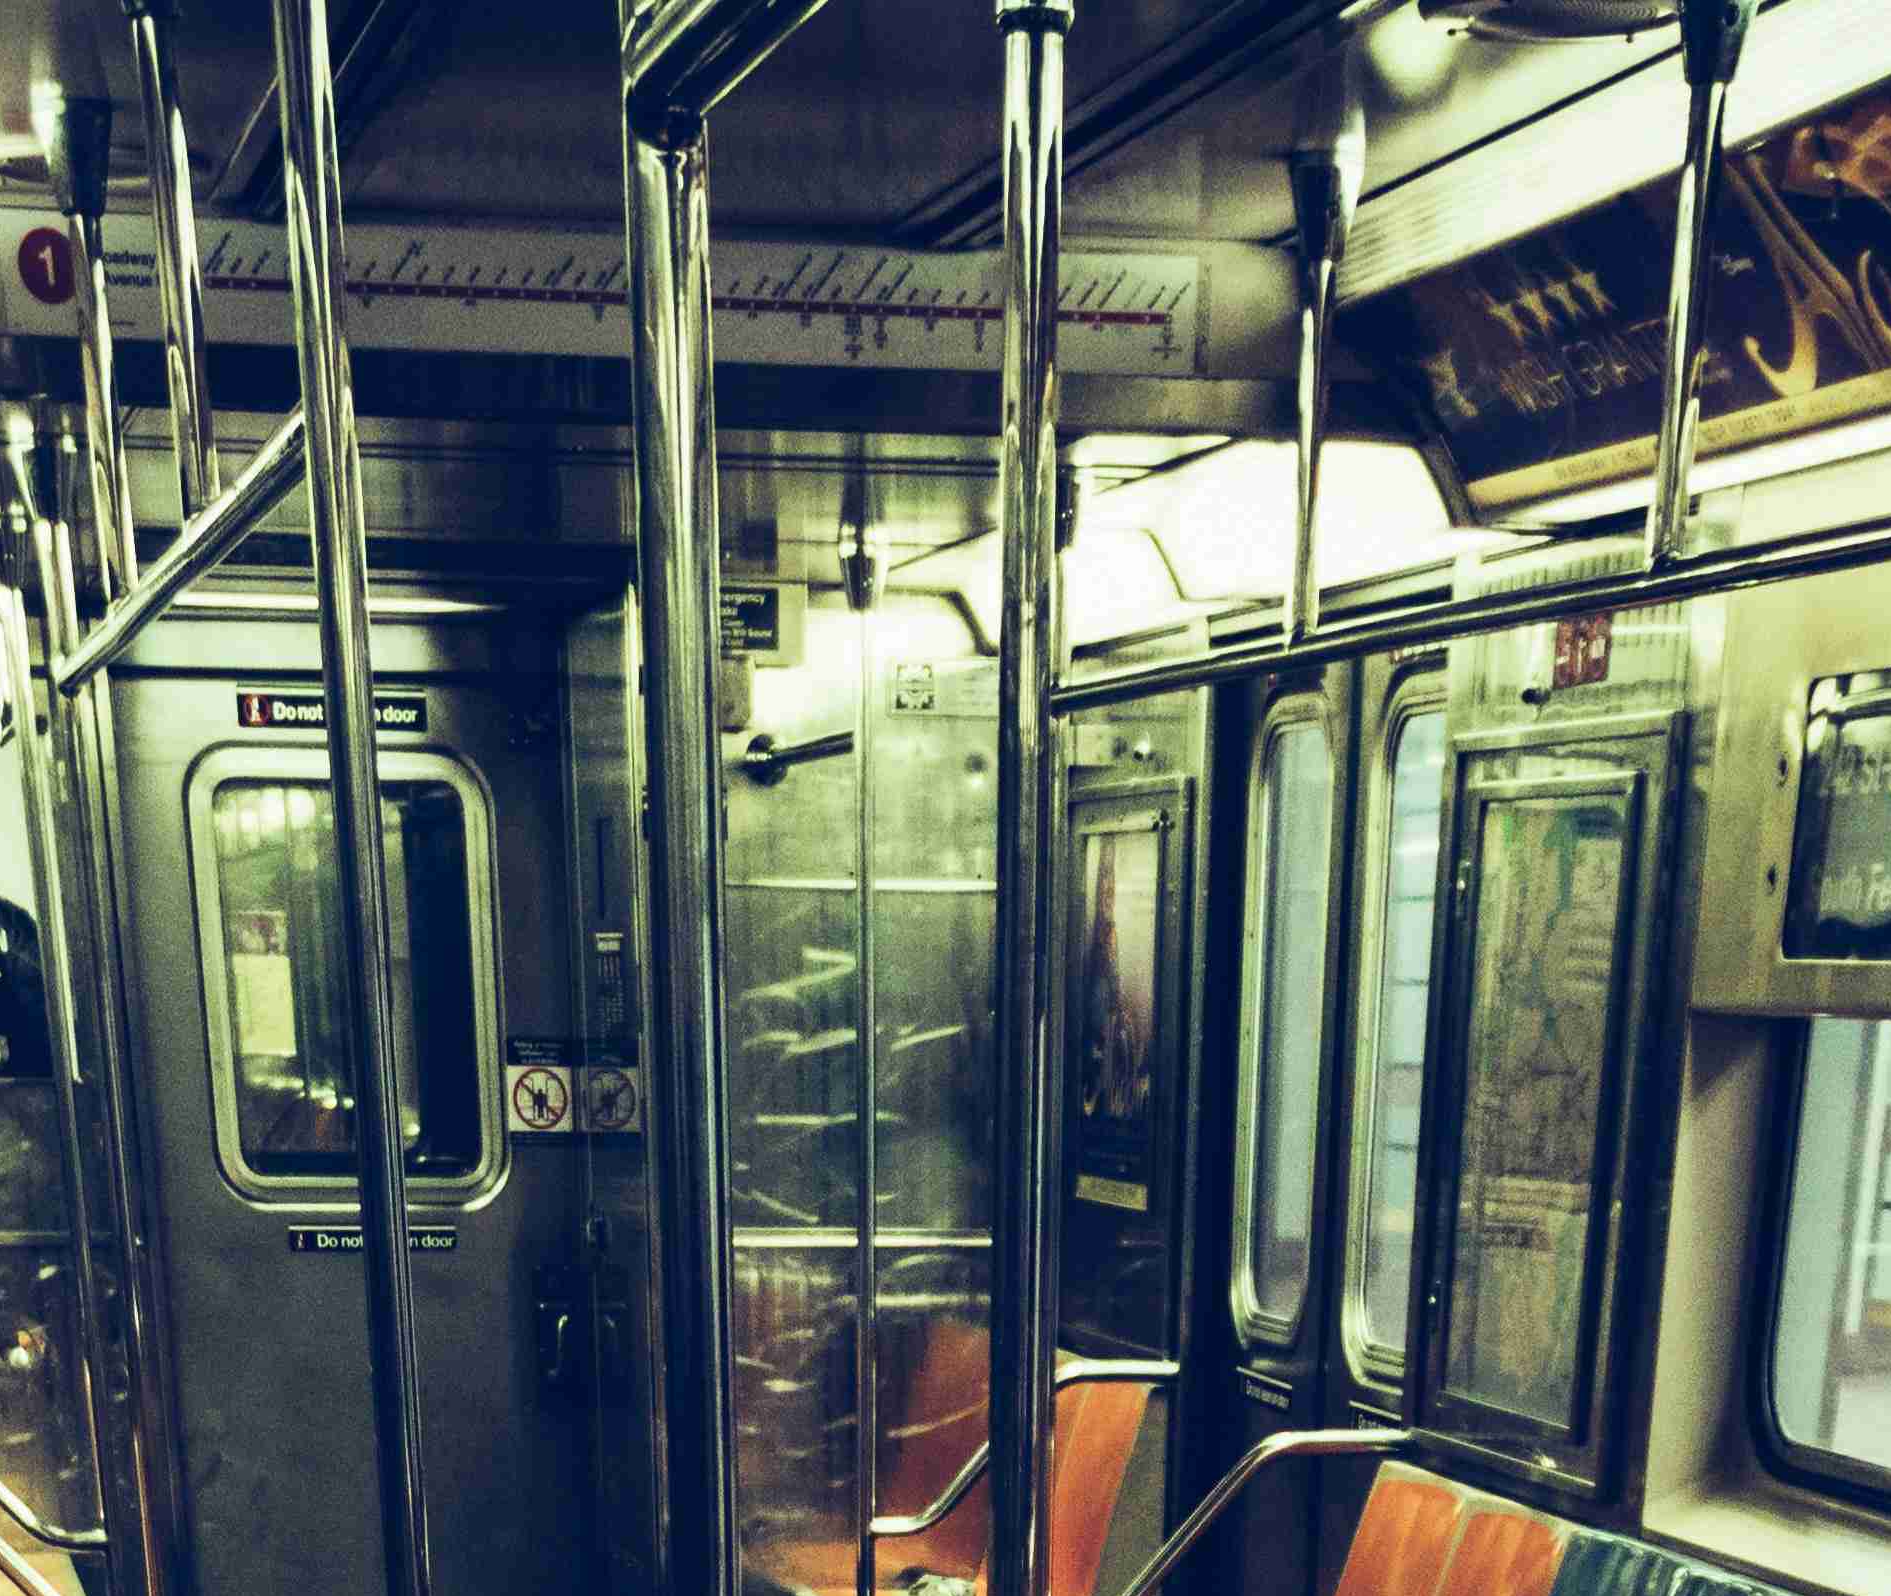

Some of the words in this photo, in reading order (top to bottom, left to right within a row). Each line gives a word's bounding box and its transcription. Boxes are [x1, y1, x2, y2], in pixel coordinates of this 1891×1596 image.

[38, 244, 57, 288] 1
[272, 701, 297, 720] Do
[297, 703, 324, 721] not
[383, 705, 418, 723] door
[316, 1233, 338, 1248] Do
[421, 1234, 455, 1249] door
